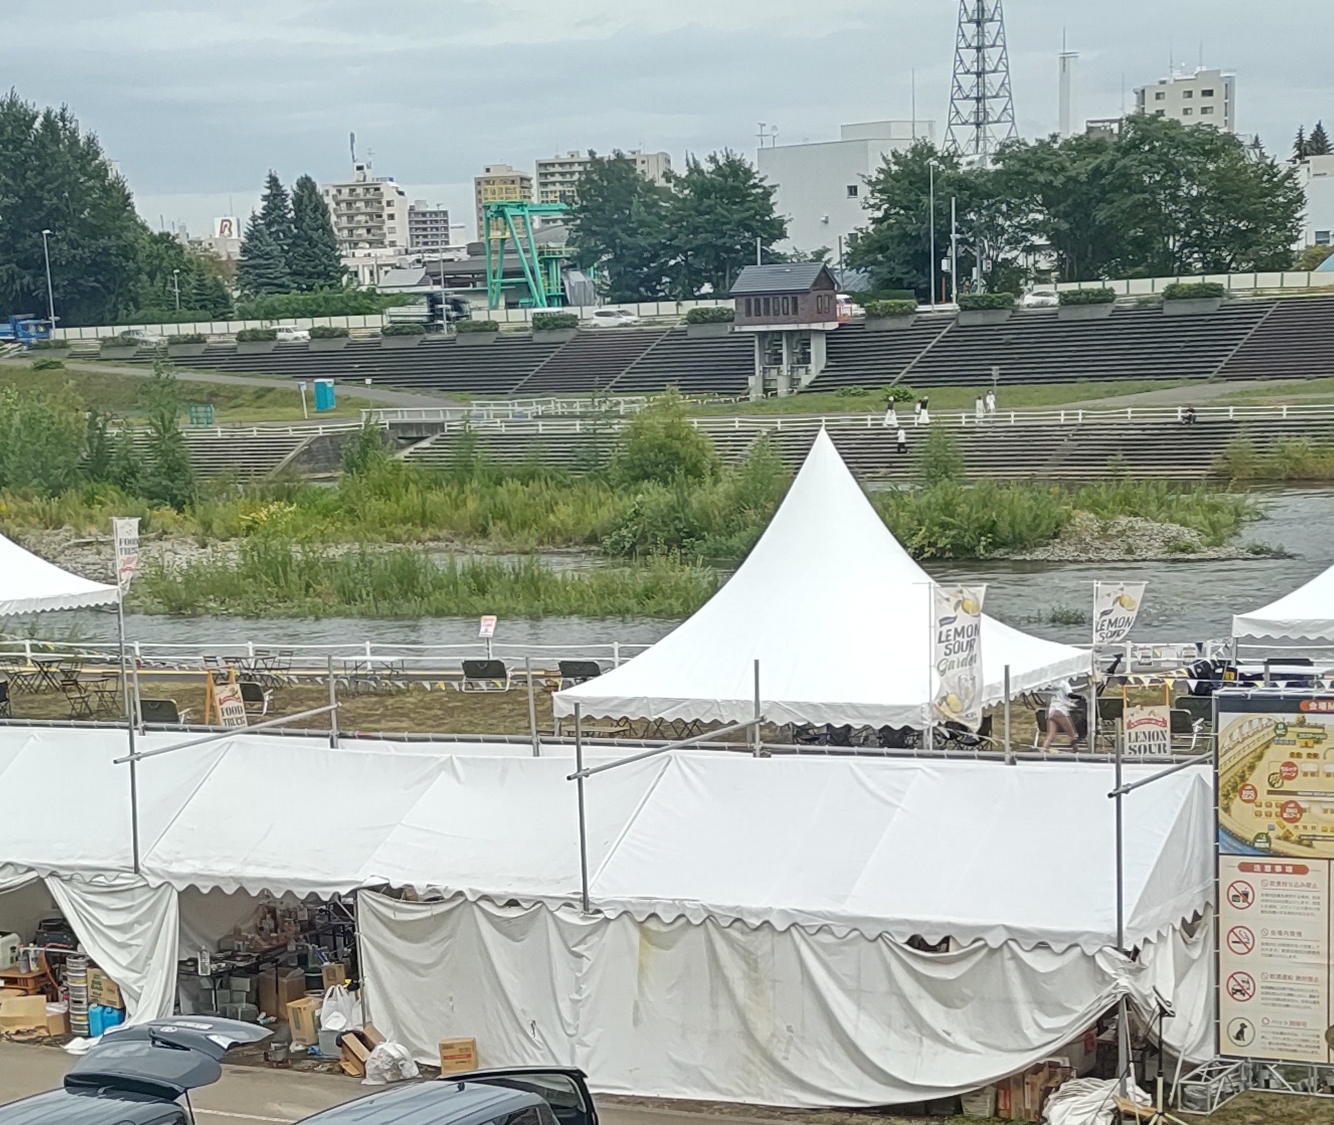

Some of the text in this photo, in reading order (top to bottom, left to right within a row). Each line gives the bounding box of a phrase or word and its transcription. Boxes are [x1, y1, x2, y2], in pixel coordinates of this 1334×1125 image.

[119, 538, 138, 547] FOOD
[1095, 615, 1134, 633] LEMON
[938, 623, 980, 644] LEMON
[944, 639, 977, 657] SOUR
[220, 706, 243, 718] FOOD
[1127, 730, 1168, 744] LEMON
[1128, 743, 1168, 756] SOUR
[1253, 864, 1294, 874] 注意事項
